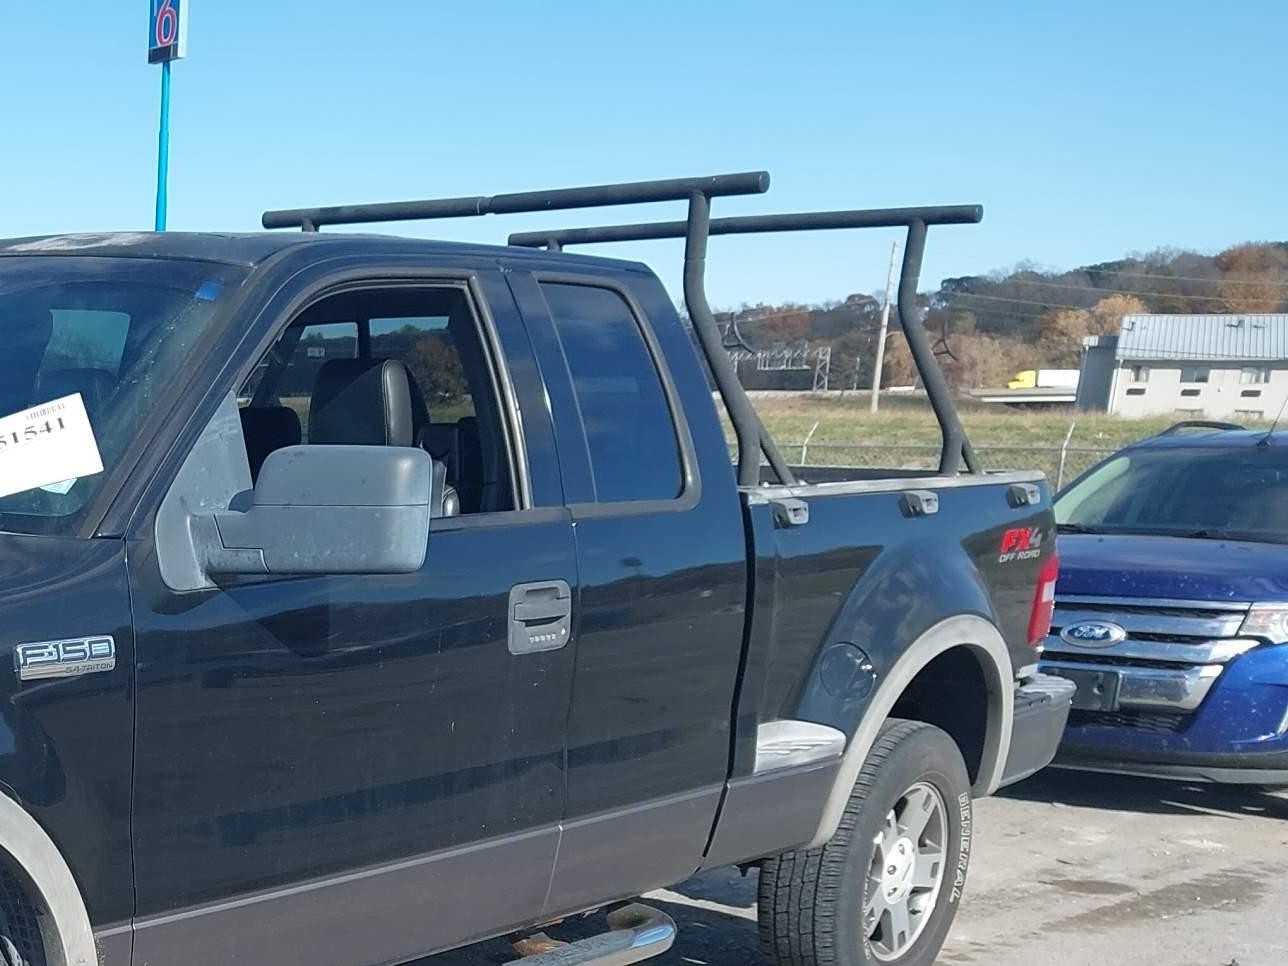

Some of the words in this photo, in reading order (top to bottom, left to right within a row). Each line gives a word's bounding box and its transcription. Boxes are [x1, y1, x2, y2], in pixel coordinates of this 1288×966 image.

[155, 0, 178, 47] 6
[999, 526, 1043, 554] FX4
[998, 551, 1017, 563] OFF
[1016, 549, 1041, 561] ROAD
